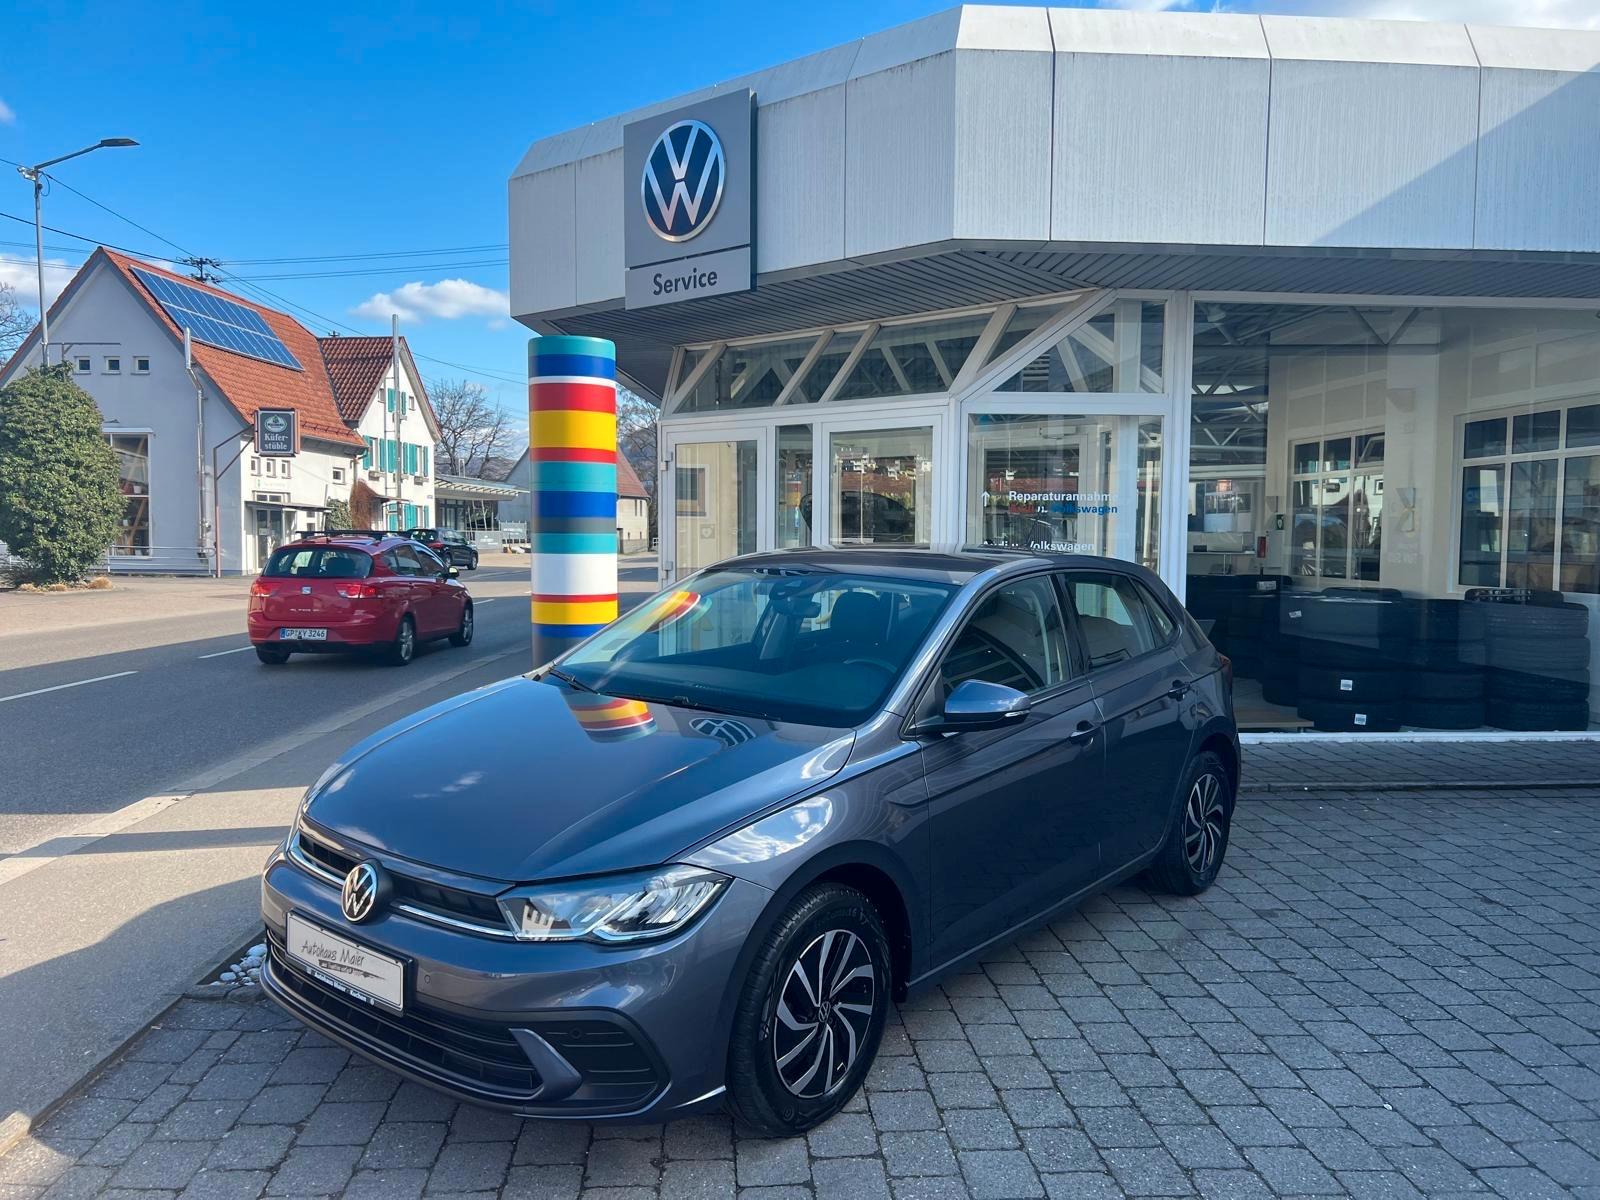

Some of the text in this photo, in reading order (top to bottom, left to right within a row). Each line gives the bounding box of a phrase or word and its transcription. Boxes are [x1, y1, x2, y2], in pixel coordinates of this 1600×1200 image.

[653, 268, 718, 295] Service
[1008, 490, 1117, 504] Reparaturannahm
[300, 939, 365, 966] Autohaus Maier
